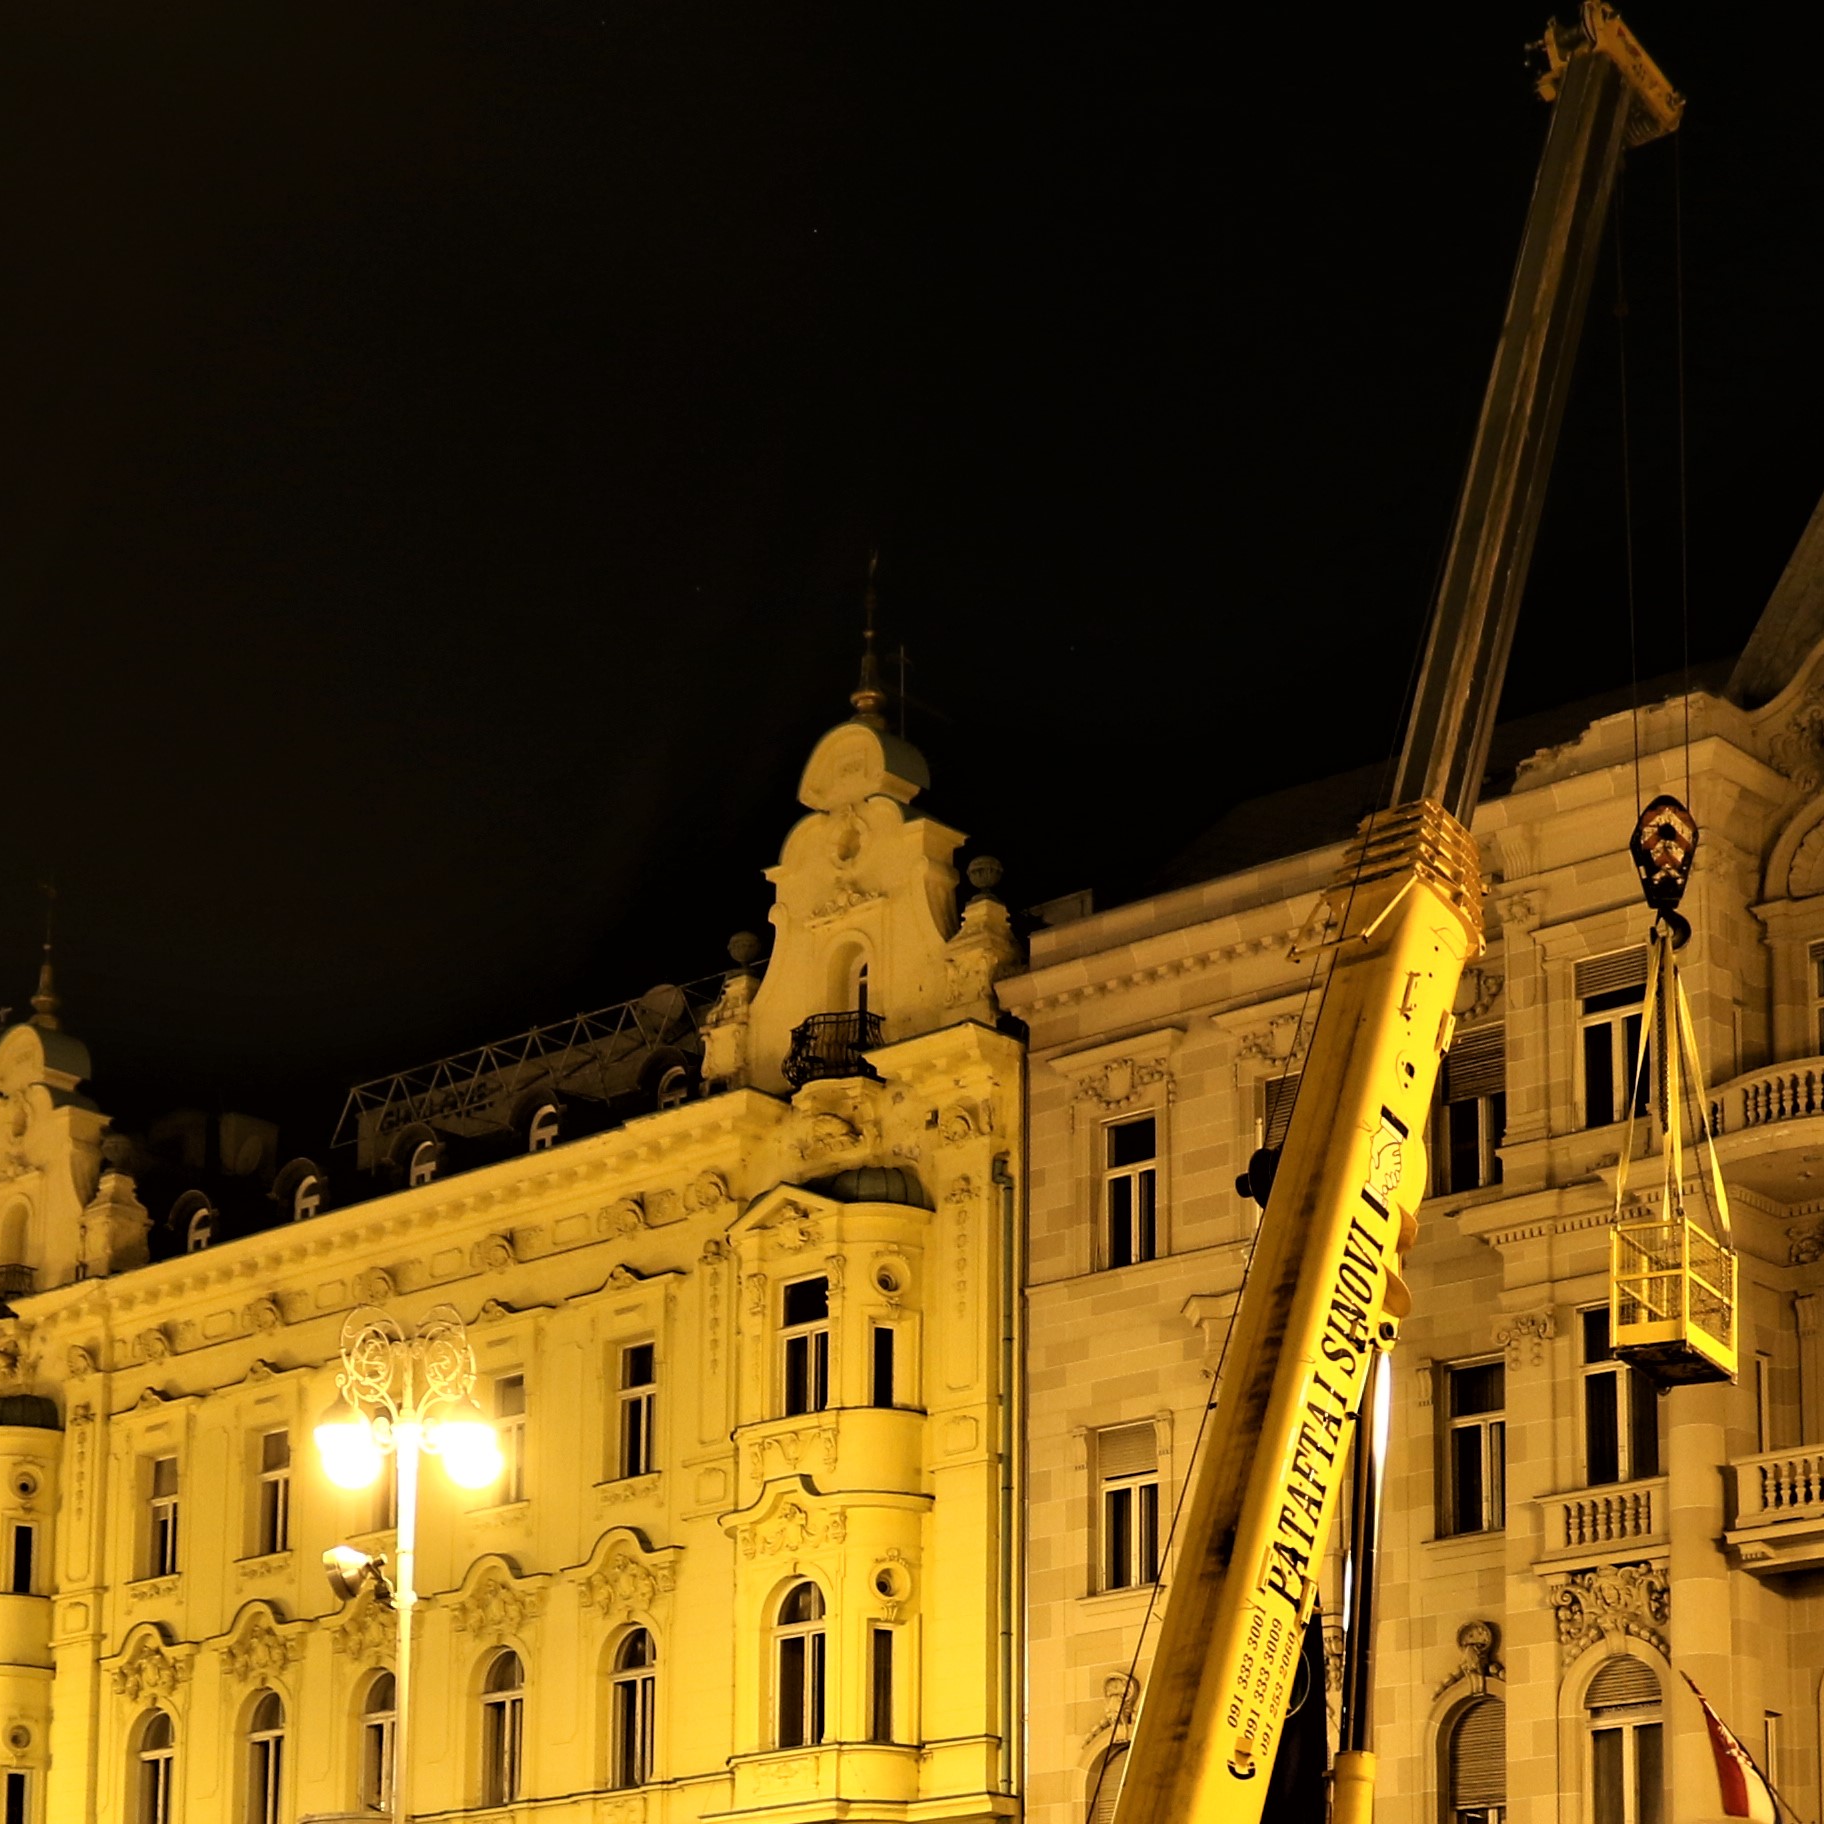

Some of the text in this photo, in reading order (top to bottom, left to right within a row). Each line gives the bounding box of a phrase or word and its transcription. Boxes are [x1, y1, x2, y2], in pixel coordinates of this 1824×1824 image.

[1267, 1216, 1384, 1613] PATAFTA I SINOVI
[1227, 1606, 1267, 1728] 091 333 3001
[1243, 1617, 1283, 1740] 091 333 3009
[1269, 1682, 1284, 1719] 253
